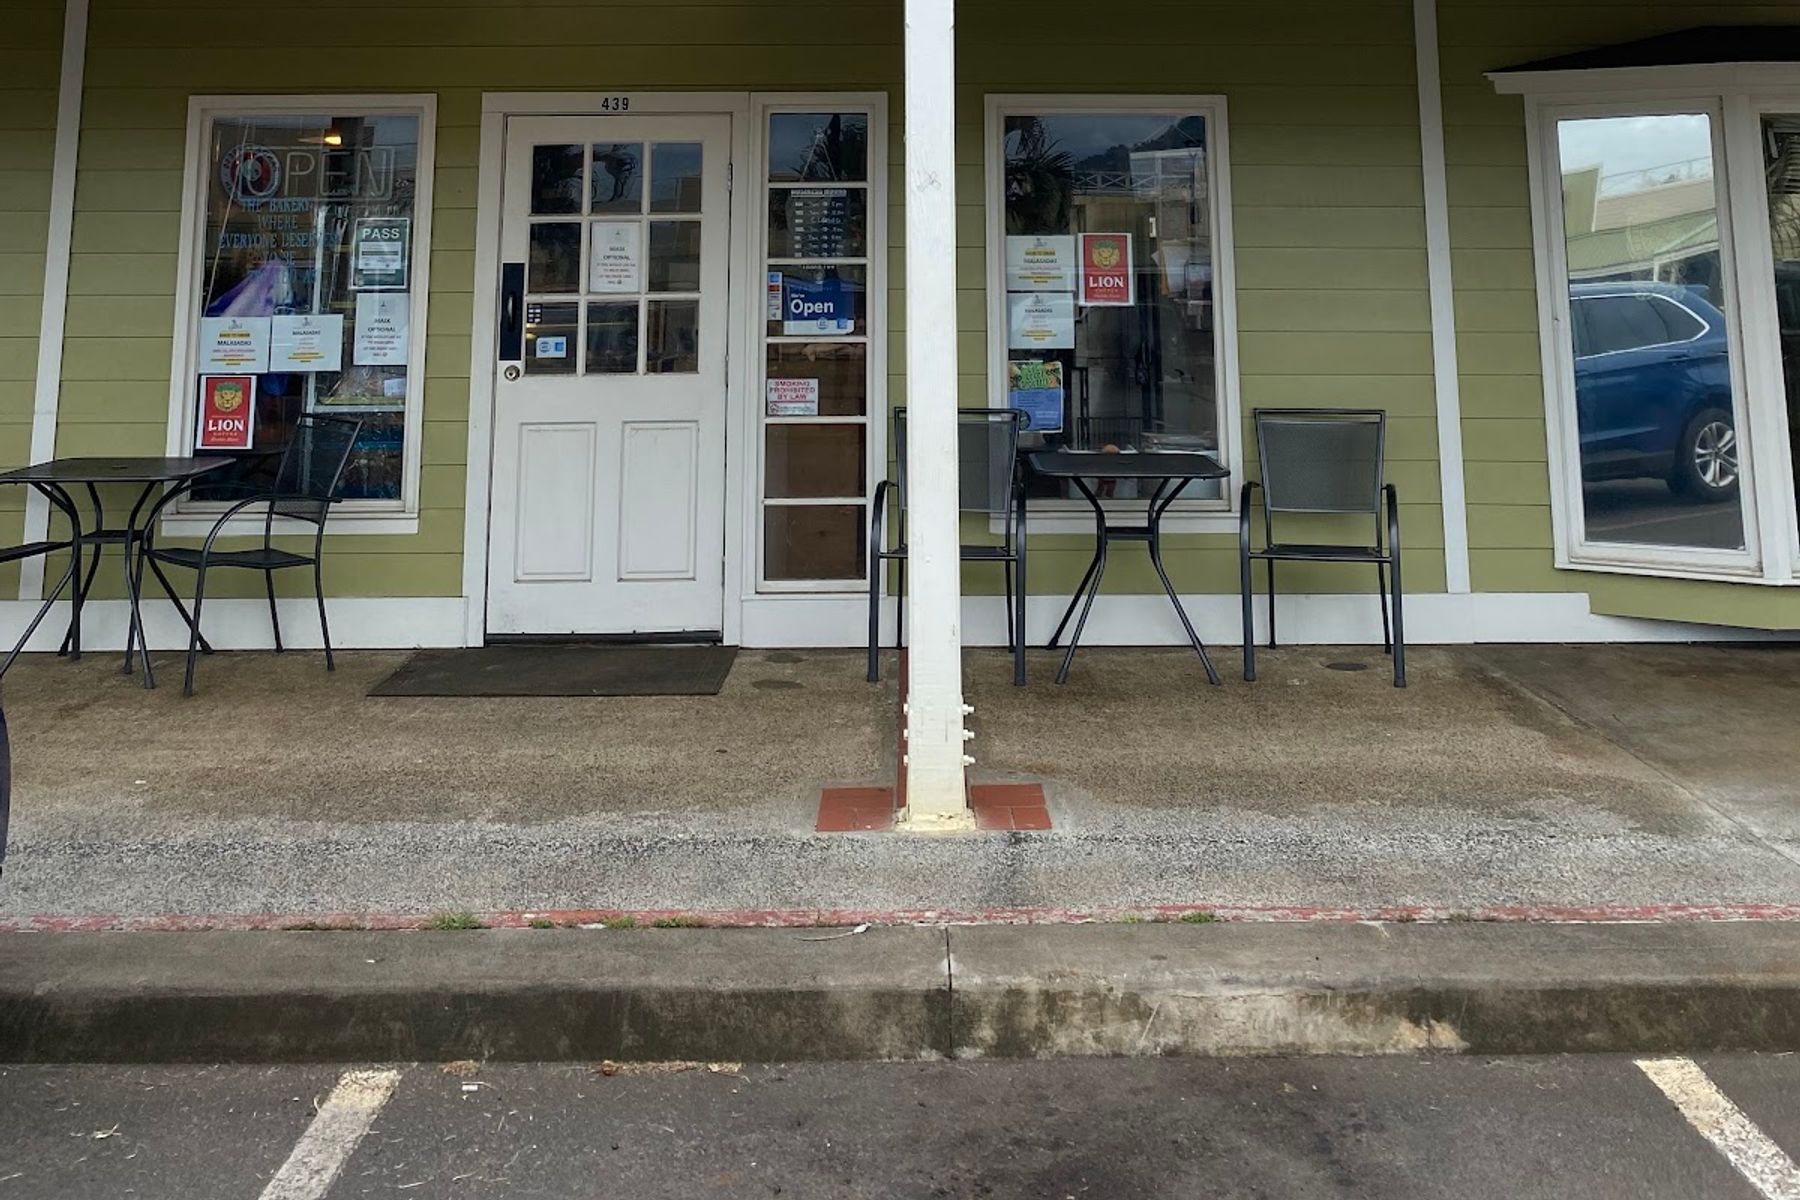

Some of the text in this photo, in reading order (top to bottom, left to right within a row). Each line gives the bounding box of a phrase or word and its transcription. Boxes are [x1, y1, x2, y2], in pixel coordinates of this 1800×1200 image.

[601, 97, 630, 111] 439
[247, 150, 388, 197] OPEN
[362, 227, 400, 240] PASS
[1088, 275, 1125, 288] LION
[790, 299, 834, 317] Open
[208, 419, 244, 432] LION
